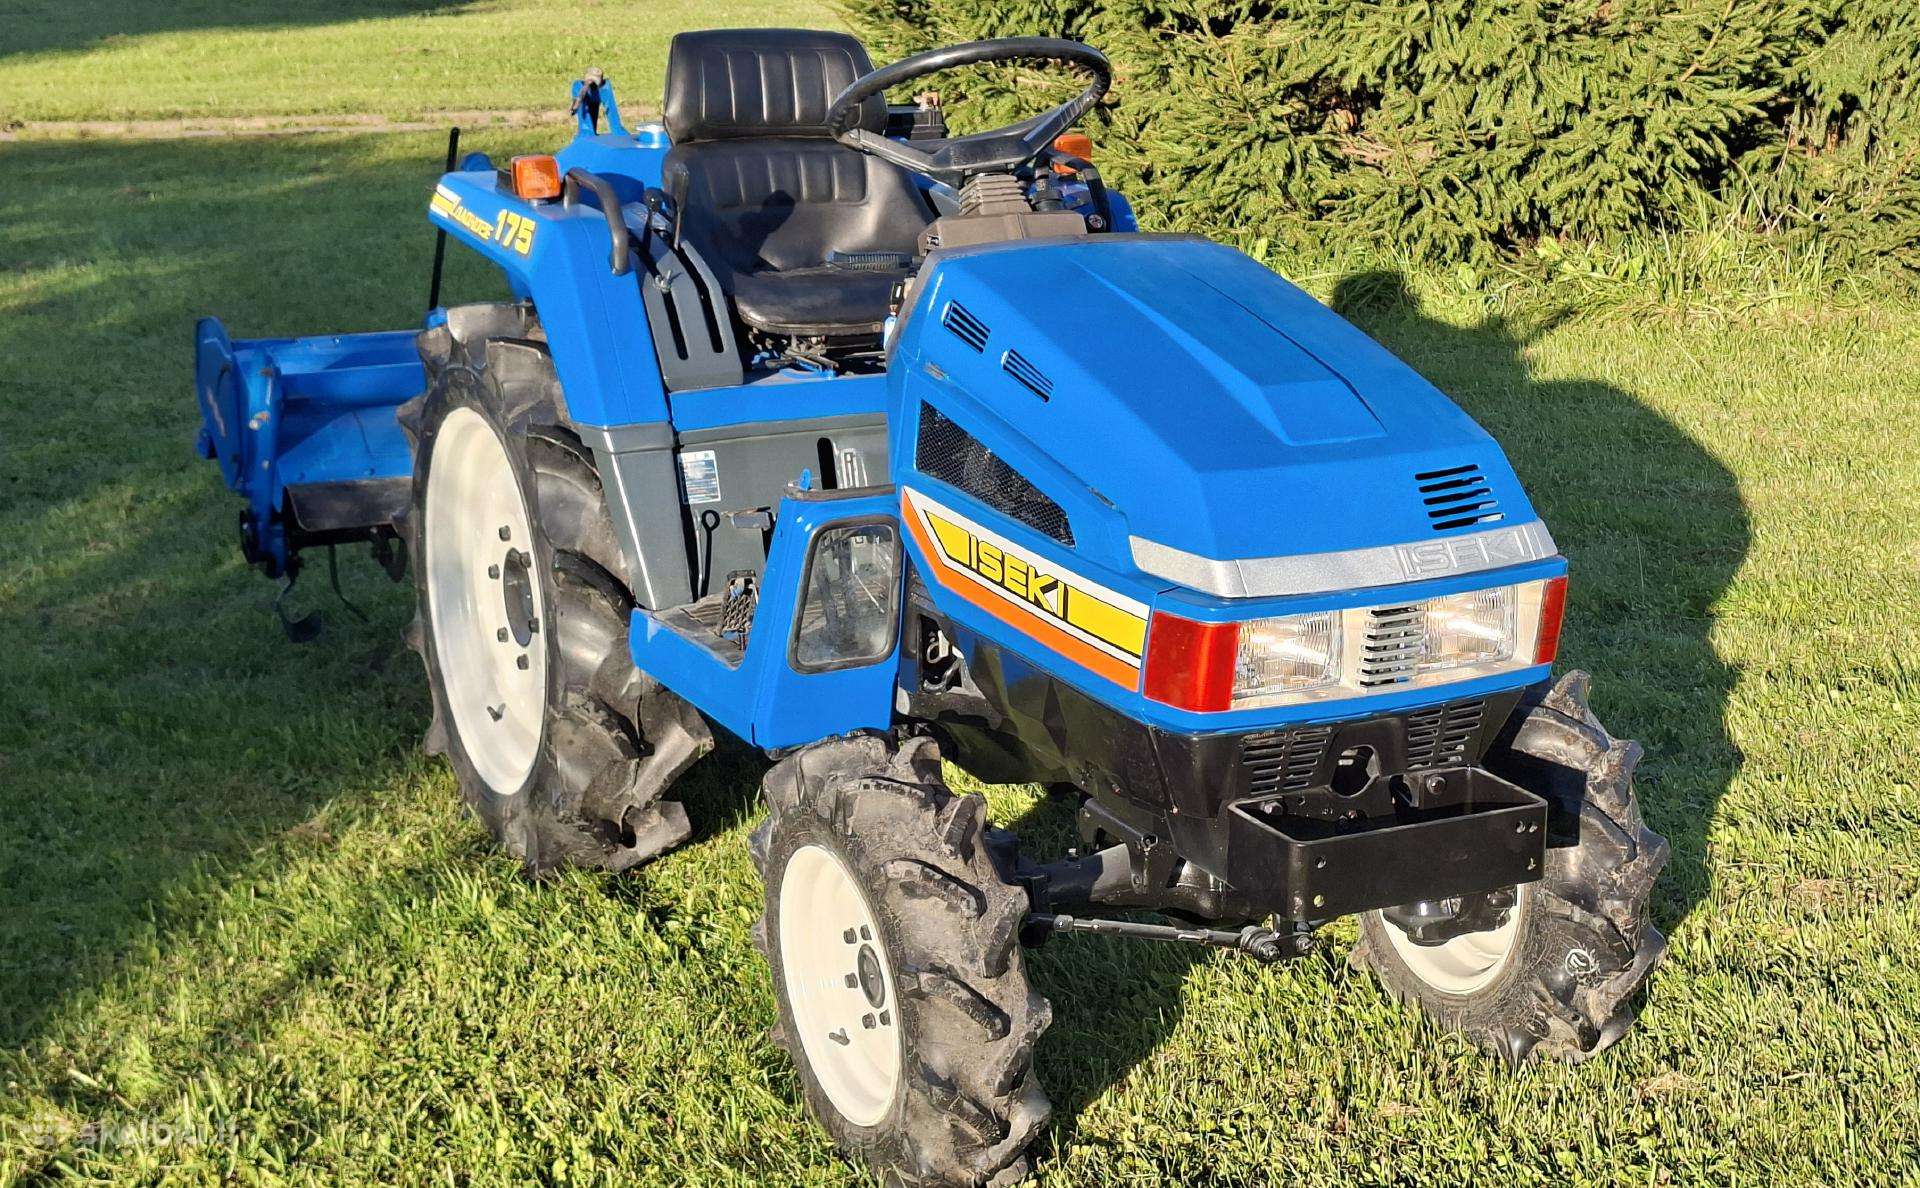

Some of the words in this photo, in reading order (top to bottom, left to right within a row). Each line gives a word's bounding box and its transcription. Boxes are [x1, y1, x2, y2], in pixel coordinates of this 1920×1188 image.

[495, 209, 536, 255] 175
[970, 534, 1067, 620] ISEKI
[1398, 525, 1544, 577] ISEKI
